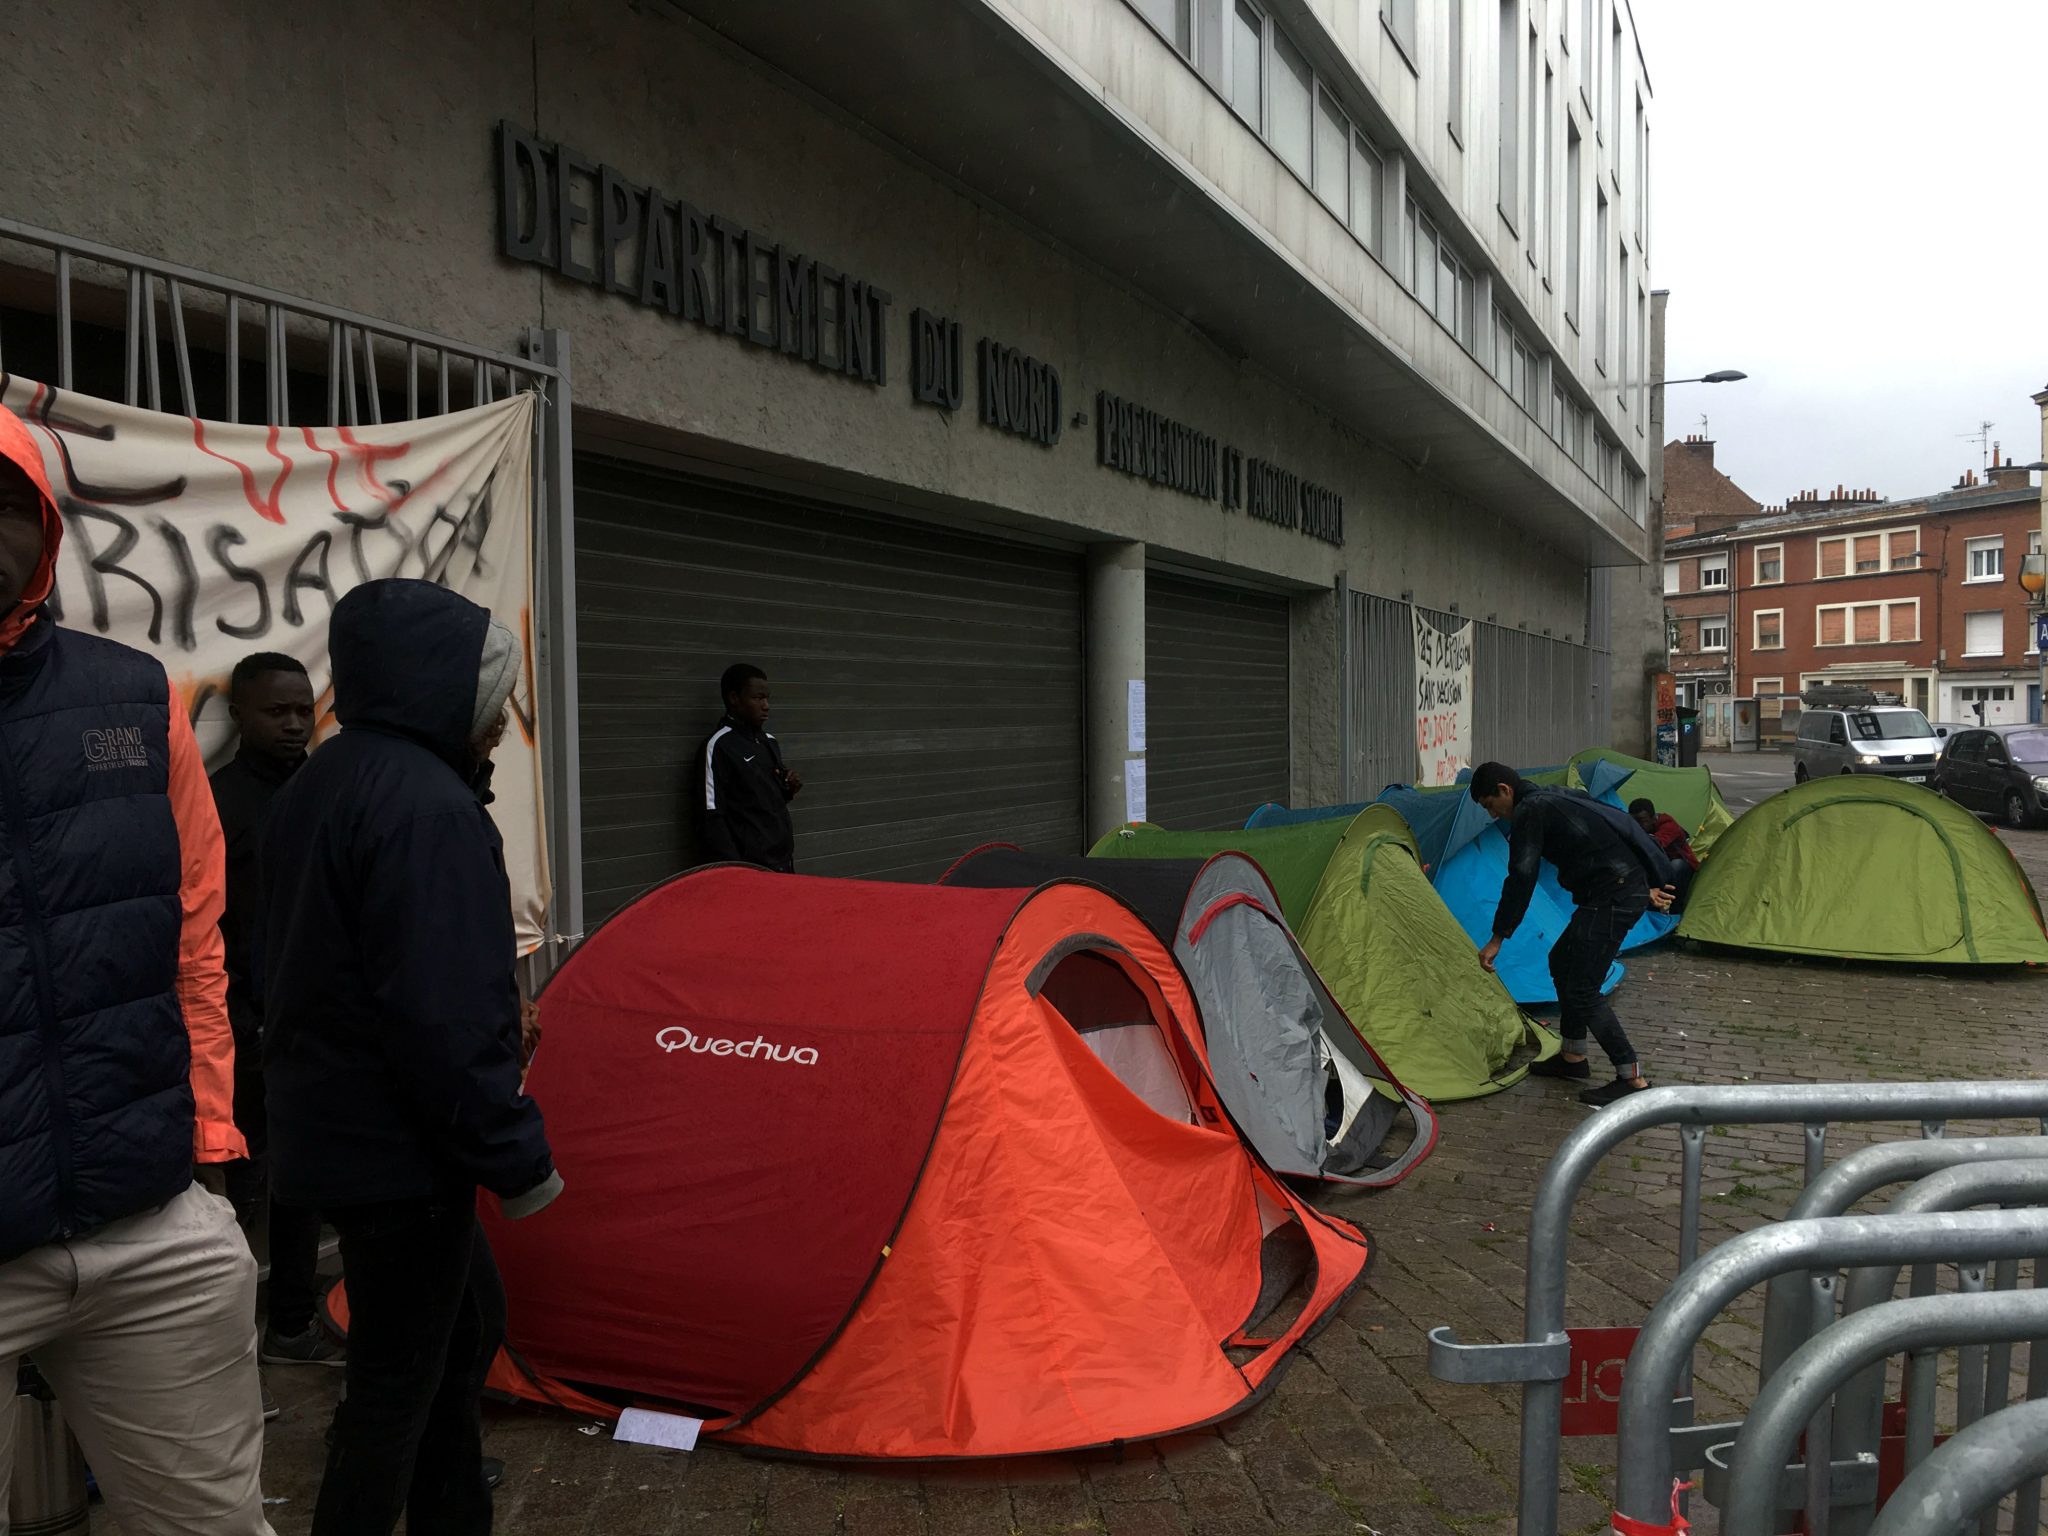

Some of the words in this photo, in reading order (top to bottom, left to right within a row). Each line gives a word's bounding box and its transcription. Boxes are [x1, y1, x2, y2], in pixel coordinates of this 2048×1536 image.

[496, 118, 893, 387] DEPARTEMENT
[912, 307, 964, 411] DU
[977, 337, 1063, 446] NORD
[1097, 390, 1219, 502] PREVENTION
[1223, 445, 1244, 510] ET
[82, 727, 142, 762] GRAND
[655, 1025, 819, 1065] Quechua
